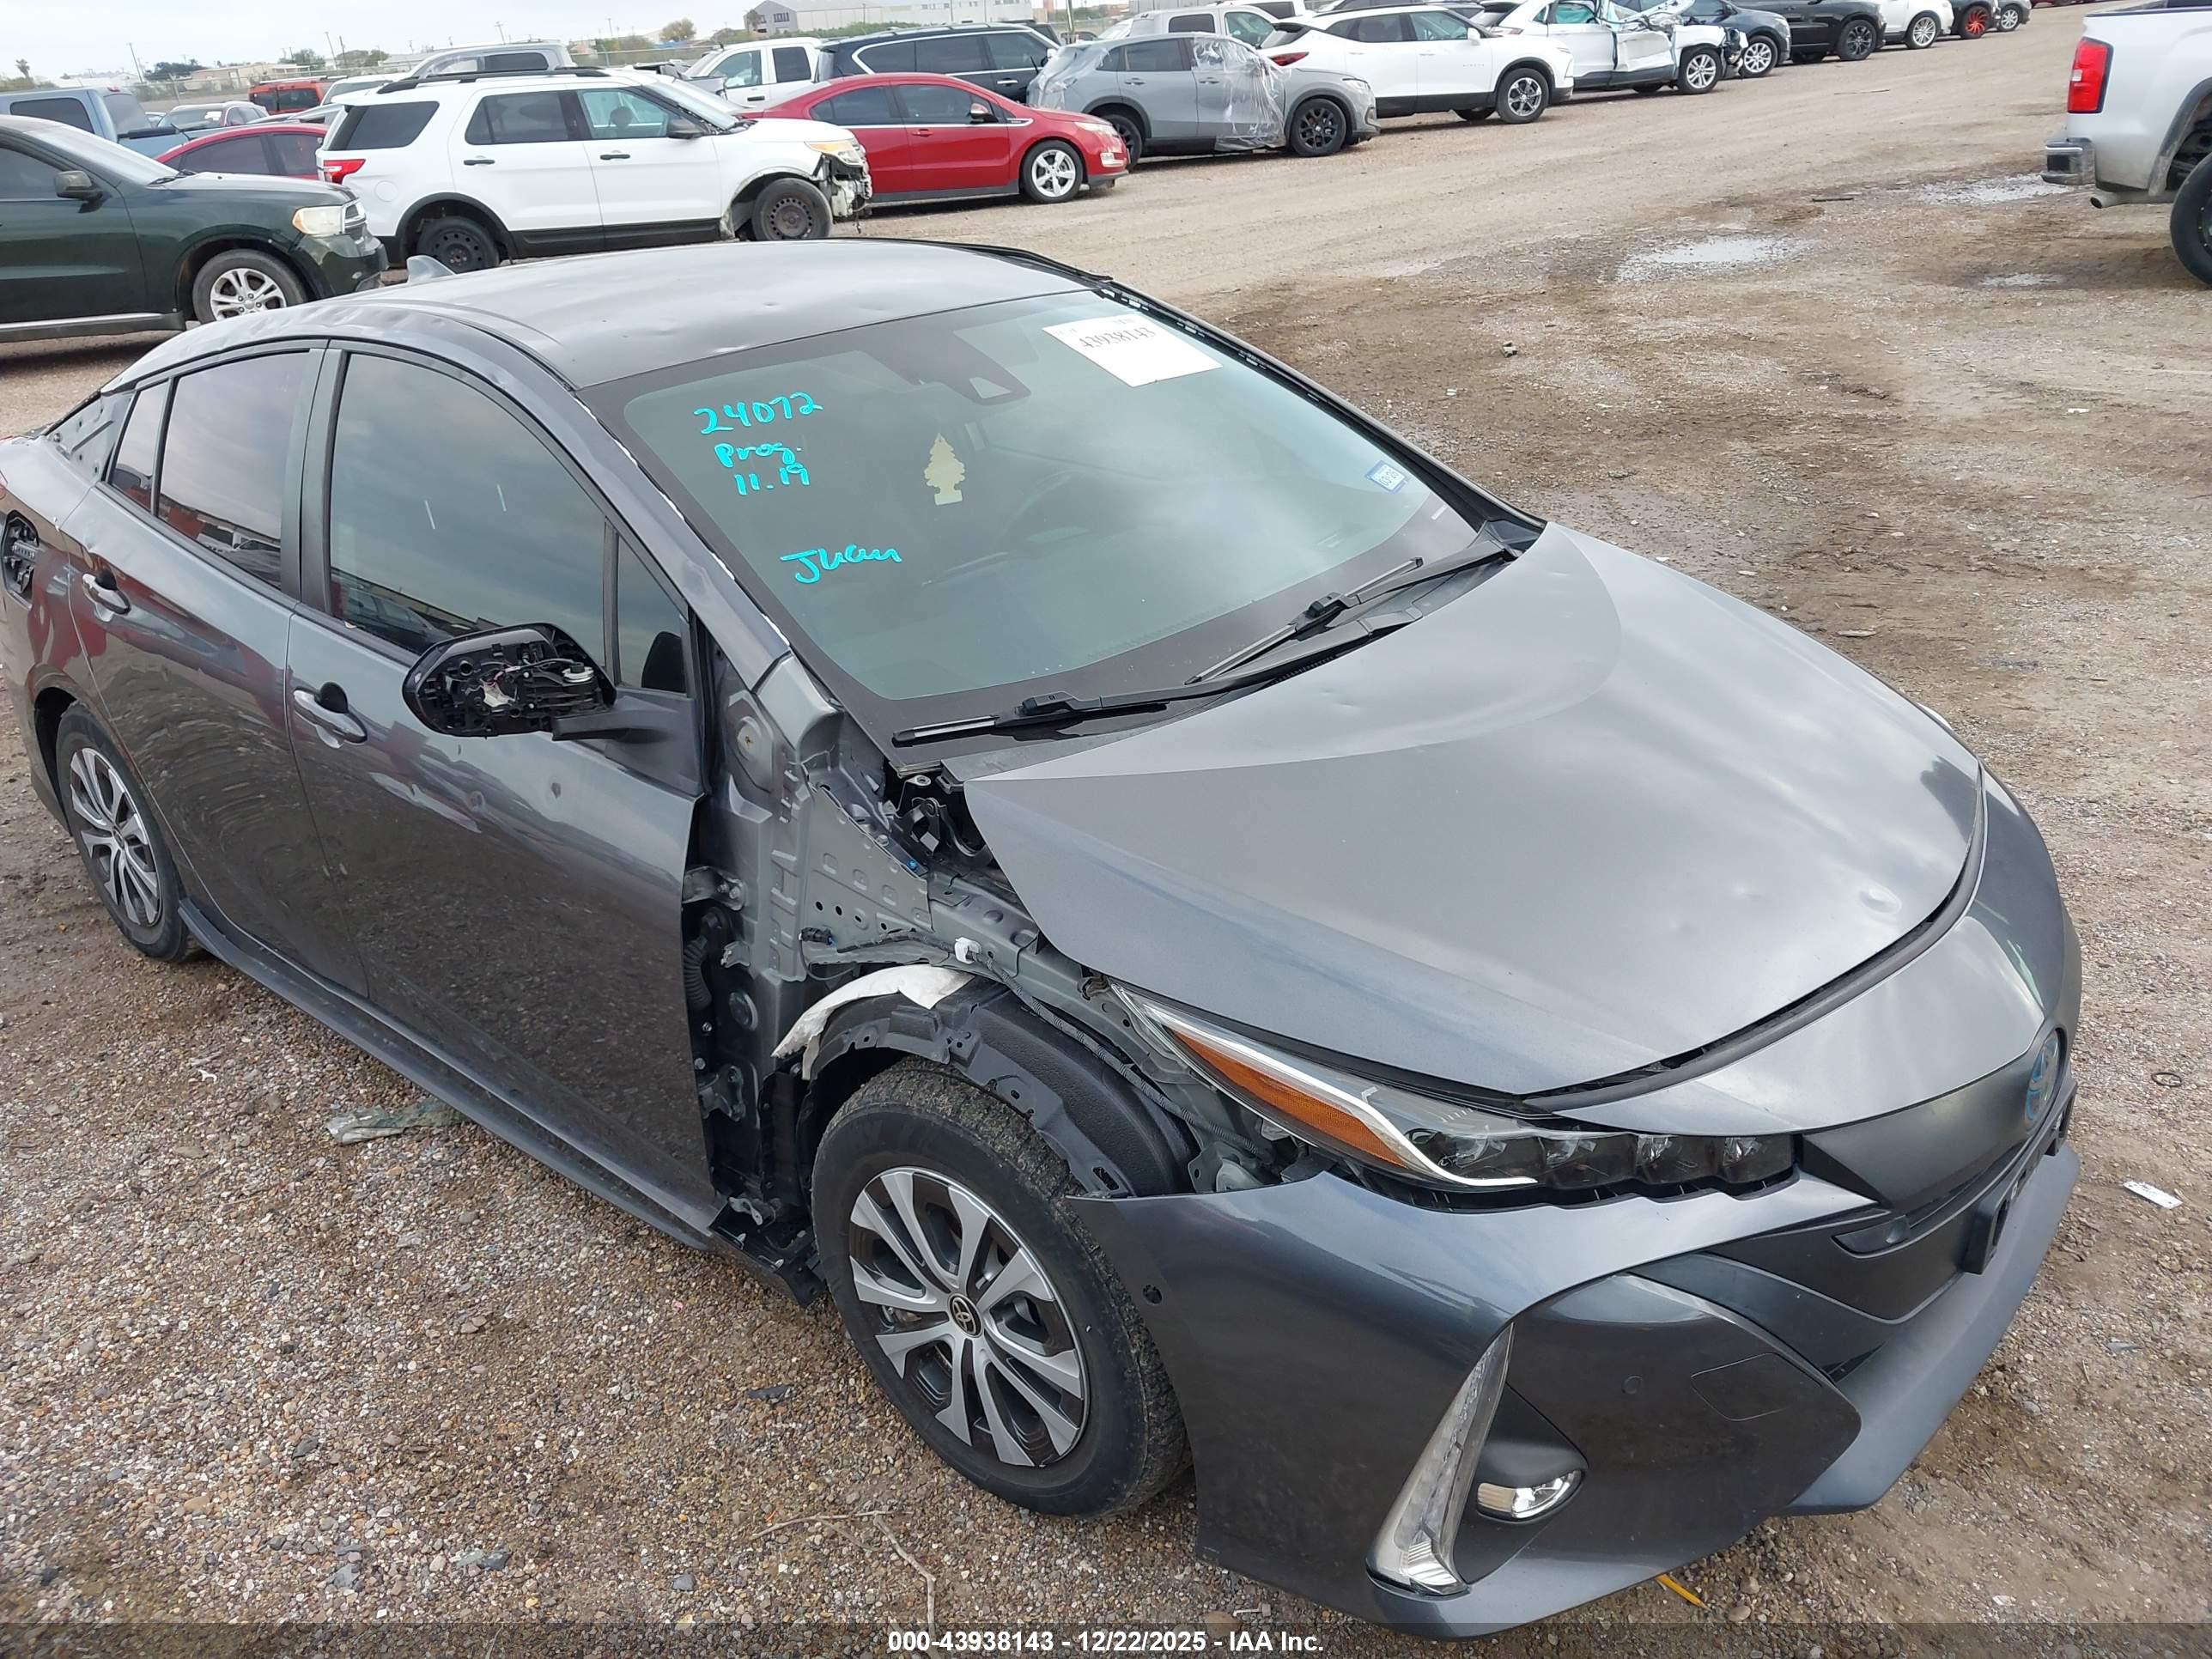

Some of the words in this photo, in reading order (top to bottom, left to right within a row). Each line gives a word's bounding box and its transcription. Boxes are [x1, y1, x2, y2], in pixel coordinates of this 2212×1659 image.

[1079, 326, 1157, 349] 43938143
[693, 392, 824, 434] 24072
[780, 544, 902, 585] Juan
